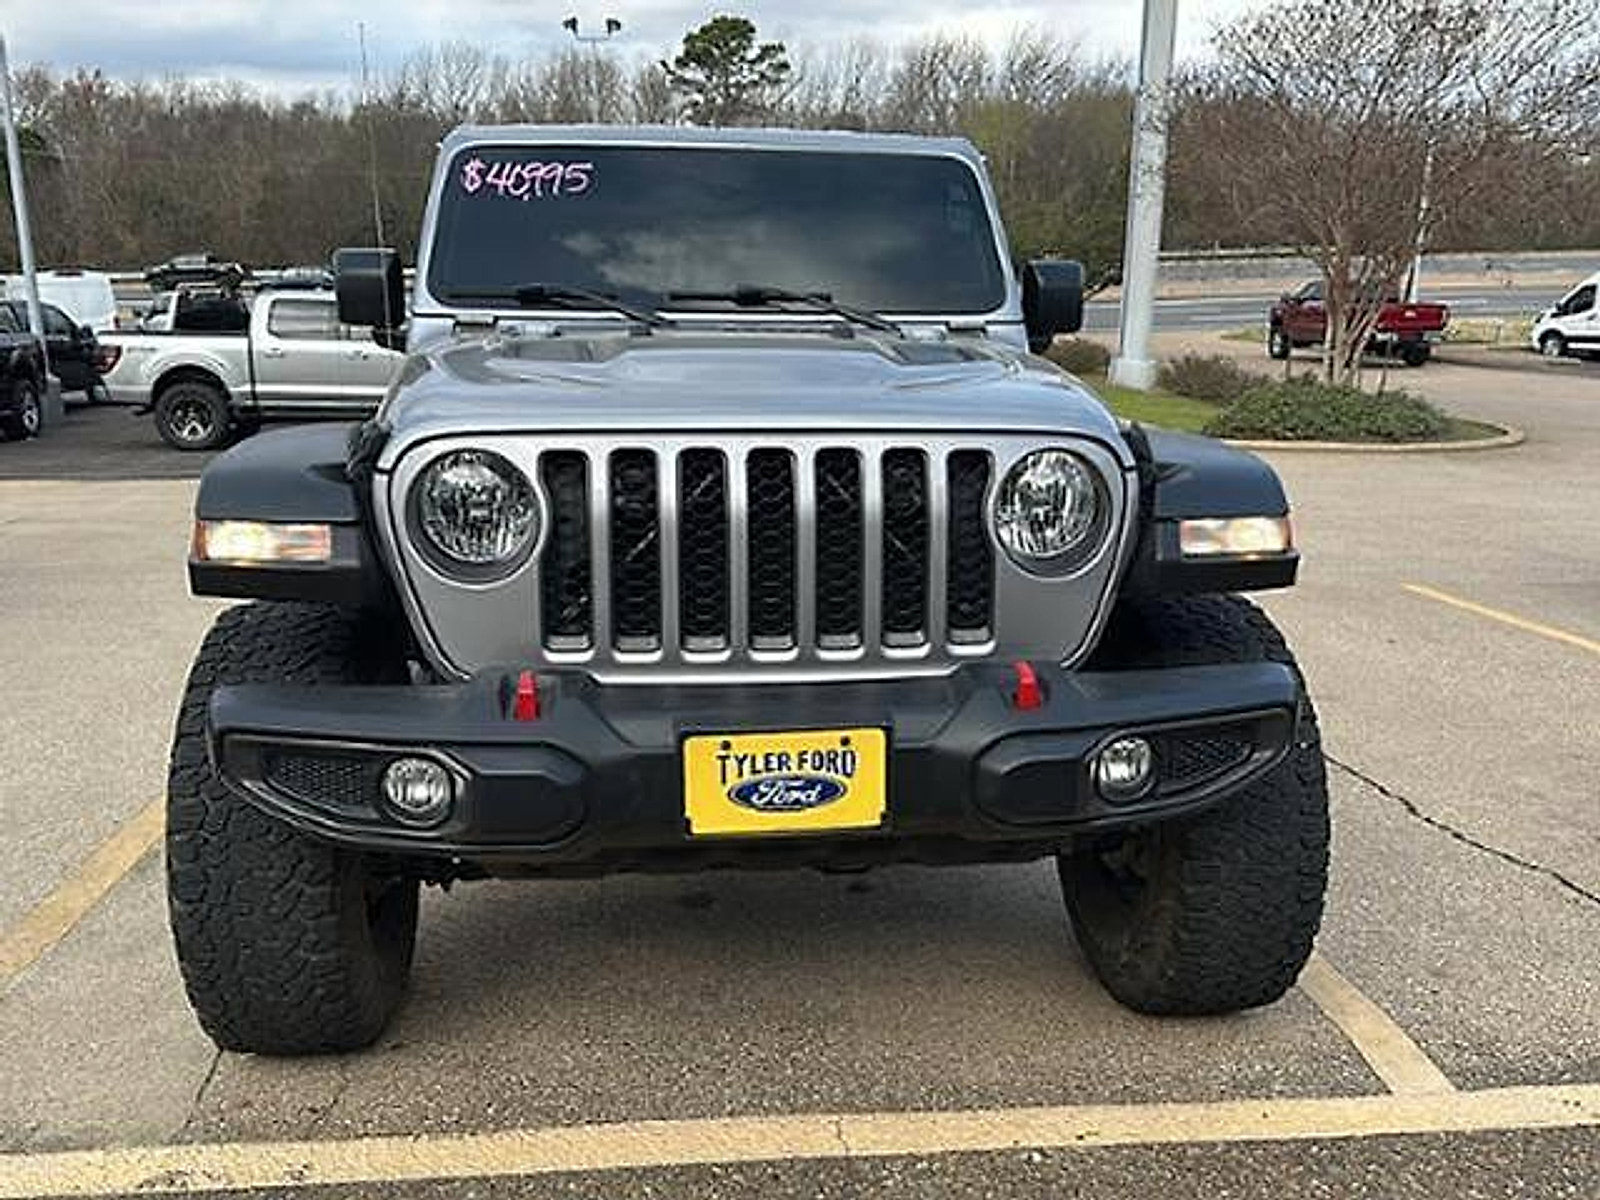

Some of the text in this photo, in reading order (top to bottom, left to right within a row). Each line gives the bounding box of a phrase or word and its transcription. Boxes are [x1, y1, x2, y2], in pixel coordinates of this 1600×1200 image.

[716, 750, 856, 784] TYLER FORD
[752, 779, 821, 804] Ford
